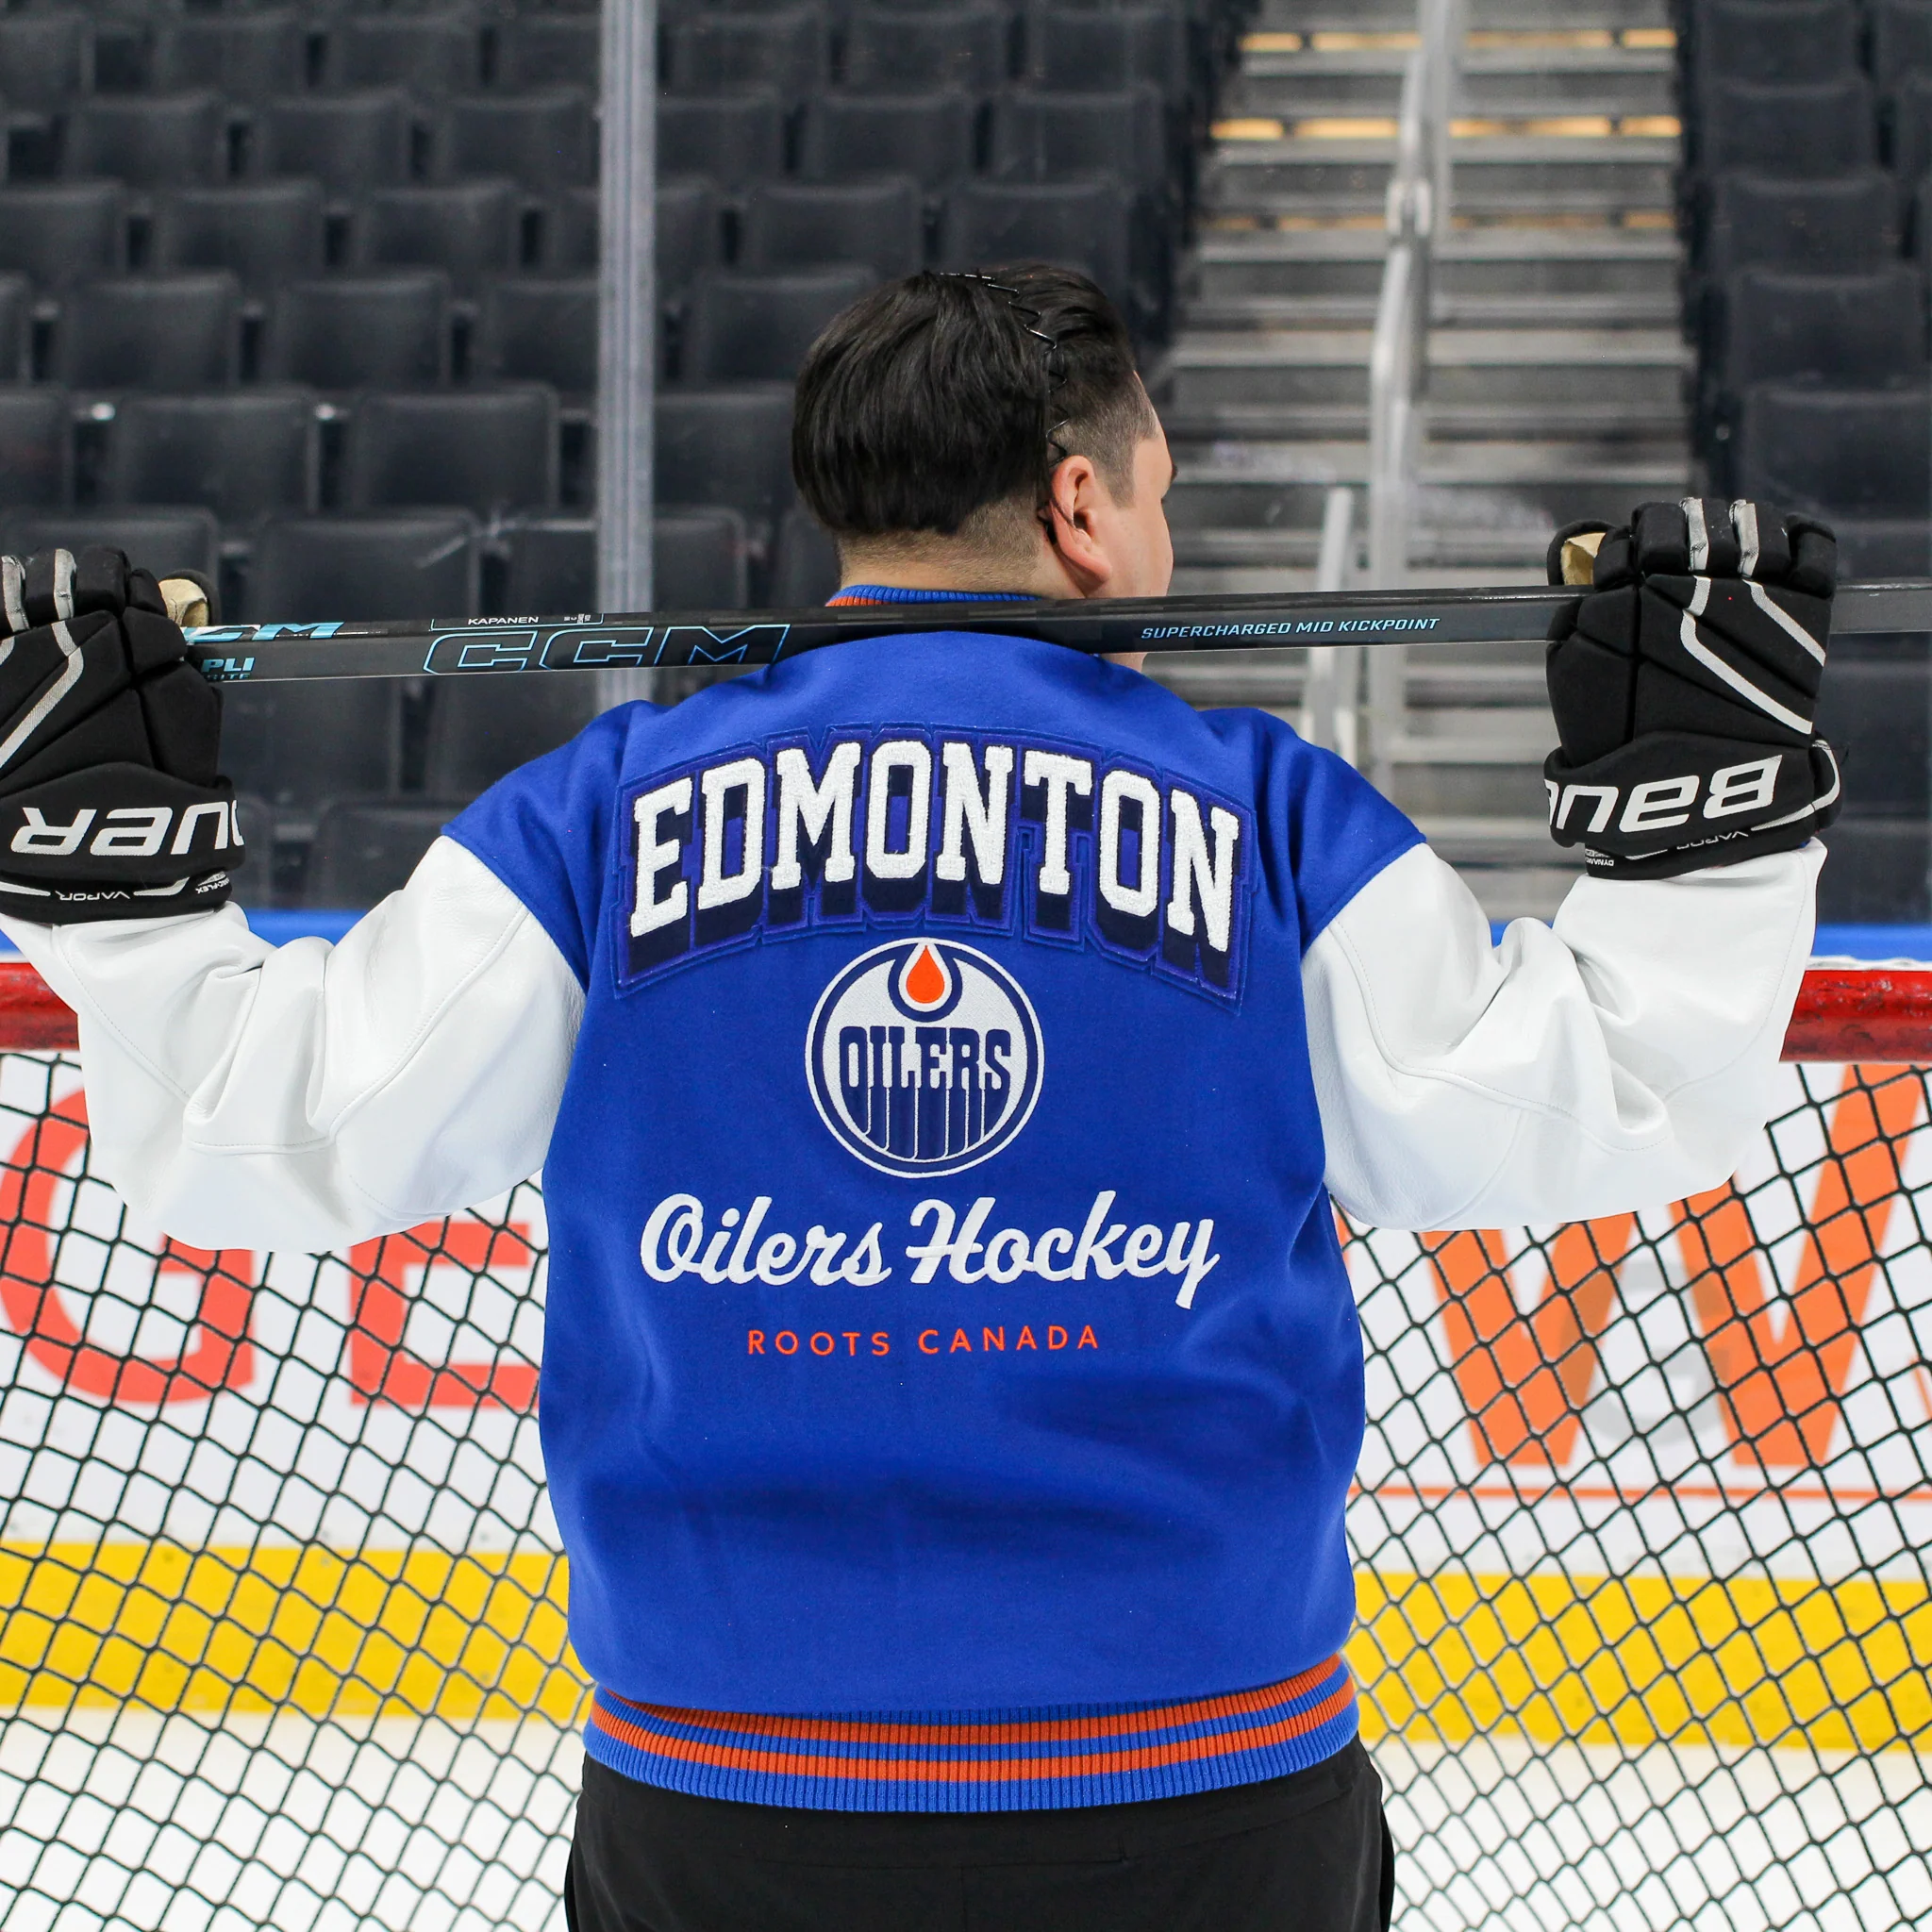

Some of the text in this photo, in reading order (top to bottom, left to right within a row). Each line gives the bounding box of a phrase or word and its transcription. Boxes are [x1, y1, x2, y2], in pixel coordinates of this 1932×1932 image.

[467, 615, 540, 625] KAPANEN
[1141, 617, 1441, 640] SUPERCHARGED MID KICKPOINT
[423, 624, 791, 675] CCM
[629, 740, 1241, 953] EDMONTON
[56, 890, 130, 902] VAPOR
[839, 1024, 1011, 1137] OILERS
[640, 1190, 1221, 1310] Oilers Hockey
[748, 1324, 1100, 1357] ROOTS CANADA
